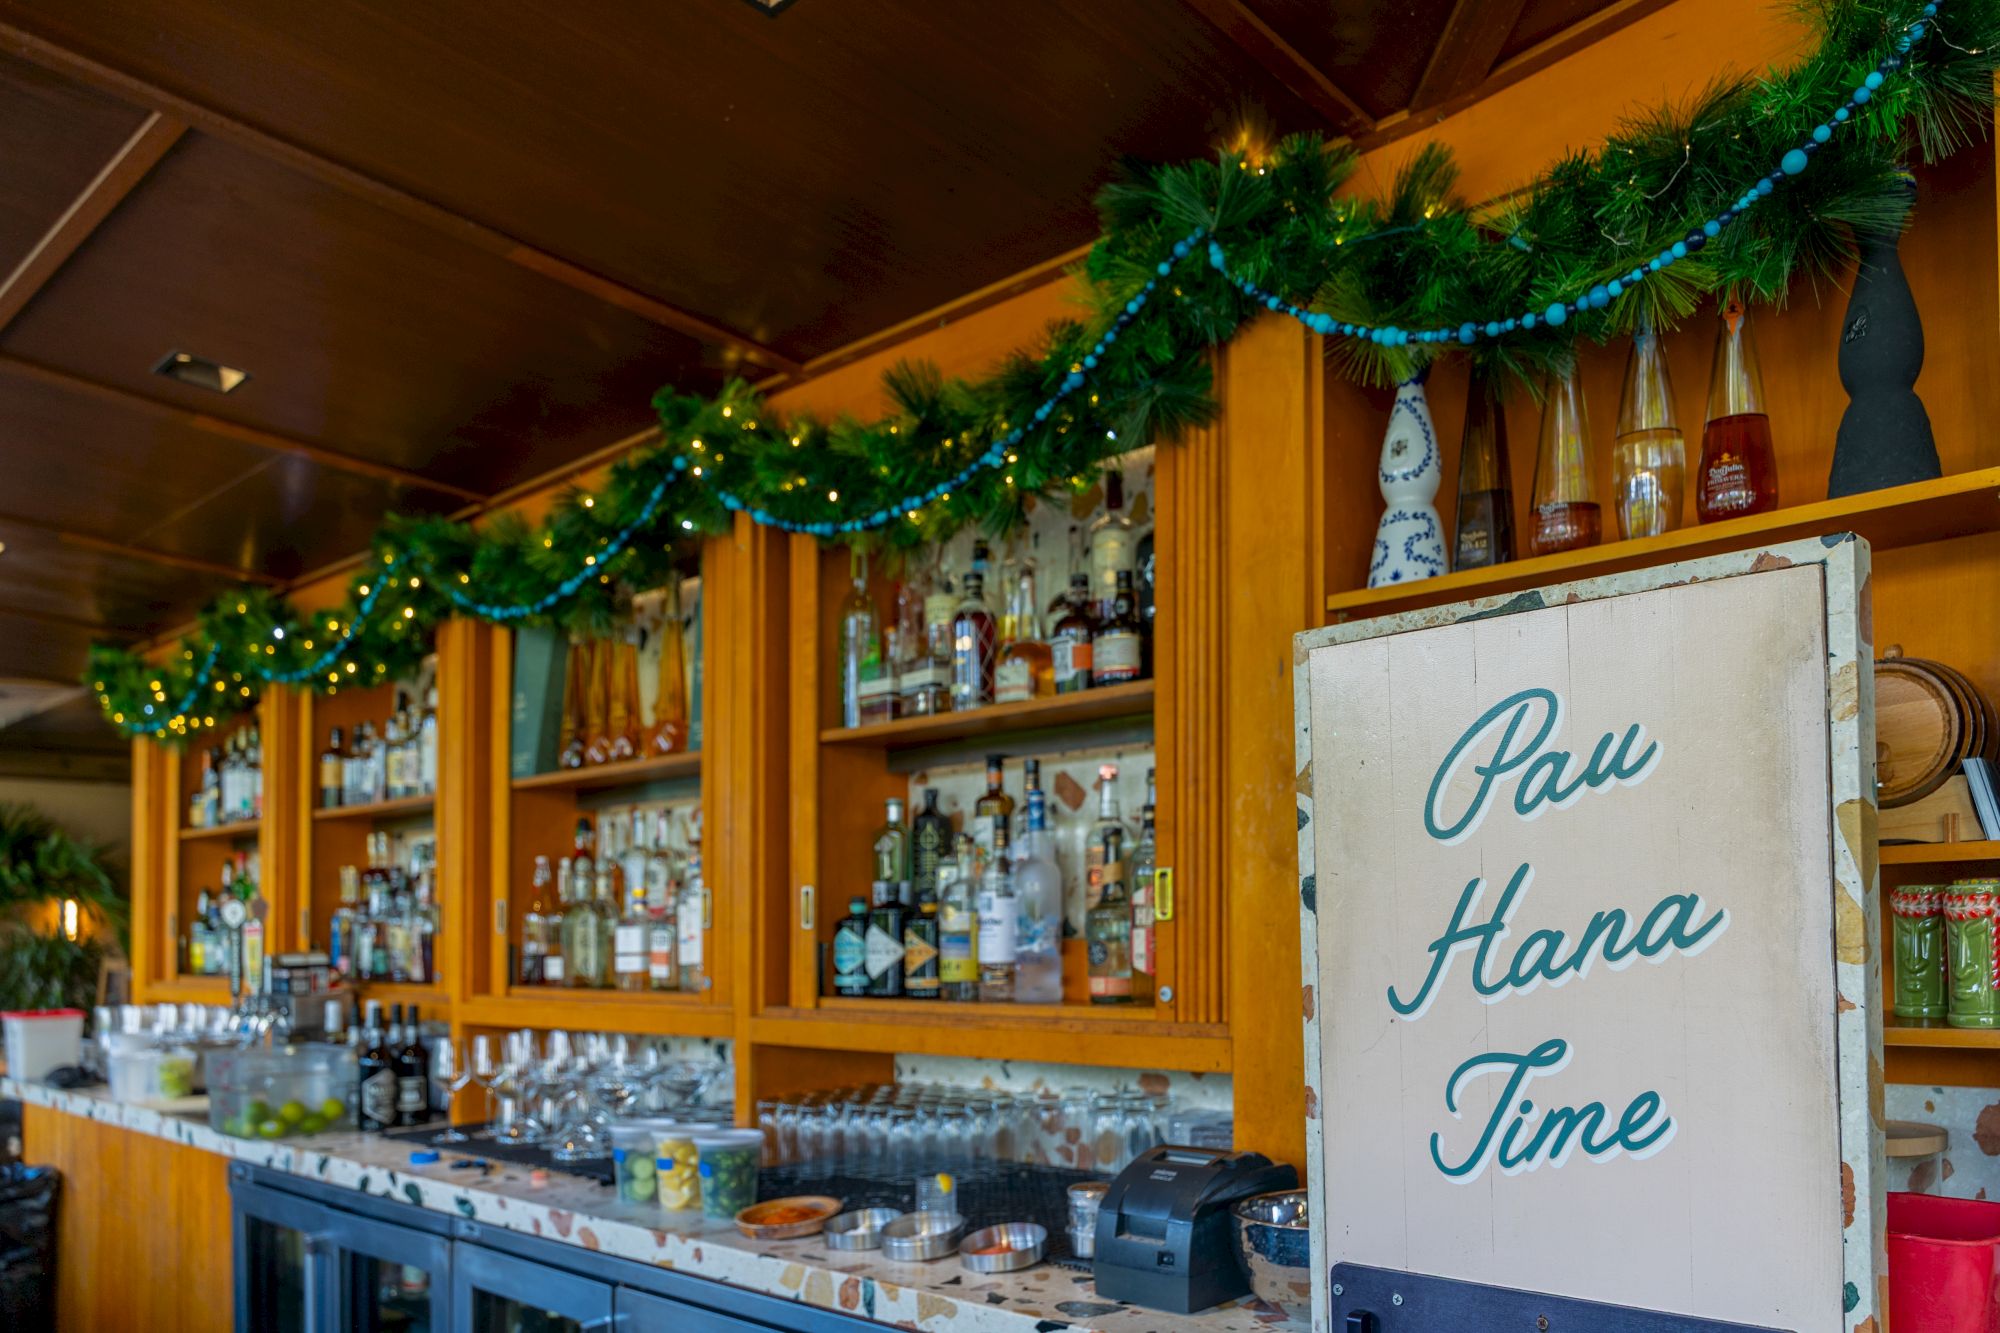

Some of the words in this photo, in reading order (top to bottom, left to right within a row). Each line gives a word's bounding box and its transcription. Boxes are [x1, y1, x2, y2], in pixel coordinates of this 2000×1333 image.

[1424, 687, 1661, 844] Pau
[1388, 863, 1728, 1019] Hana
[1430, 1039, 1675, 1182] Time
